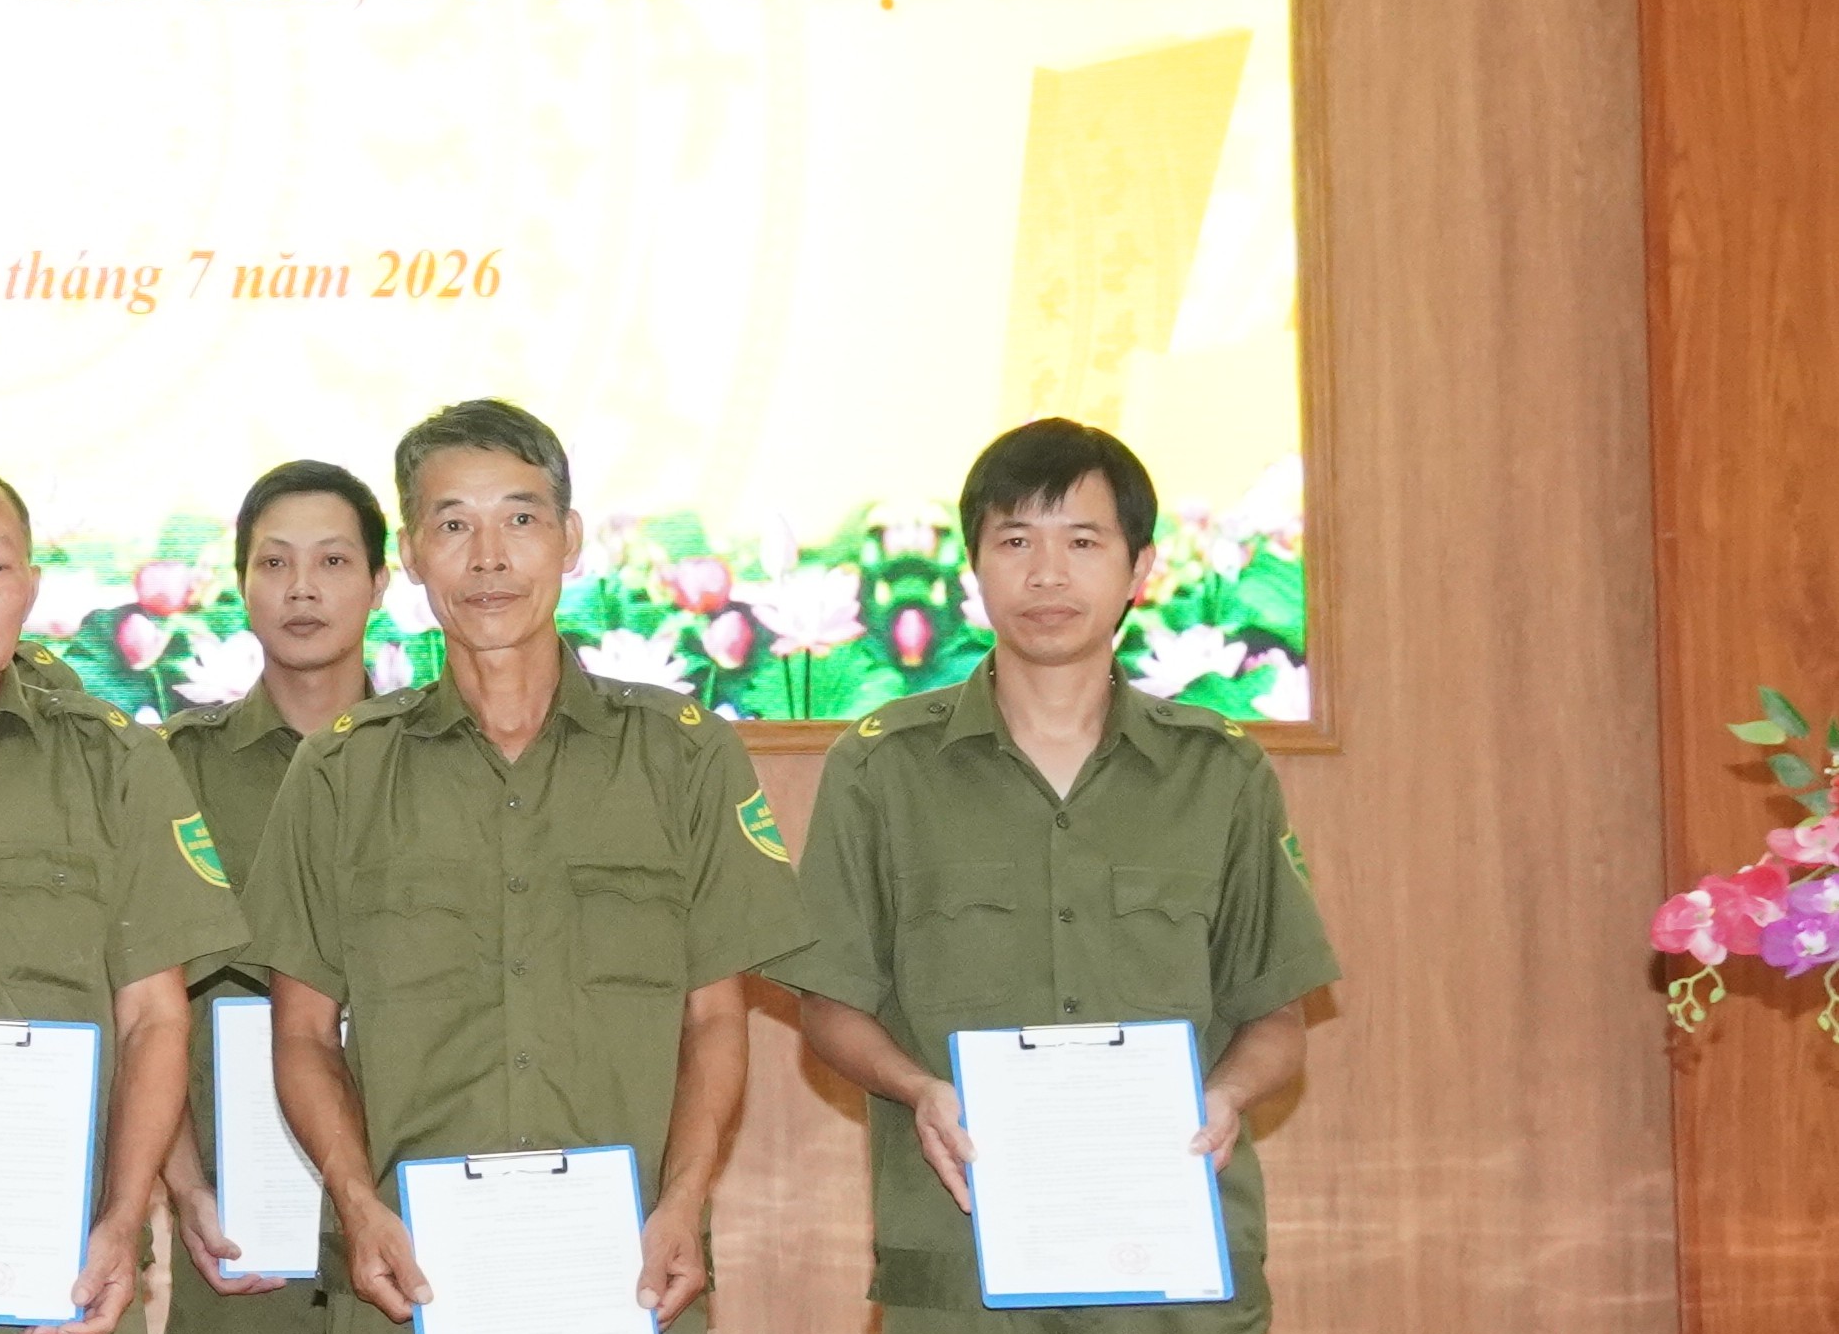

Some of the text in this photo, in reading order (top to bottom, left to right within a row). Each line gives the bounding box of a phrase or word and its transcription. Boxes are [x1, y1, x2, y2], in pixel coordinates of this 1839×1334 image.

[3, 249, 163, 315] tháng
[188, 248, 217, 300] 7
[230, 252, 352, 301] năm
[370, 247, 503, 301] 2026
